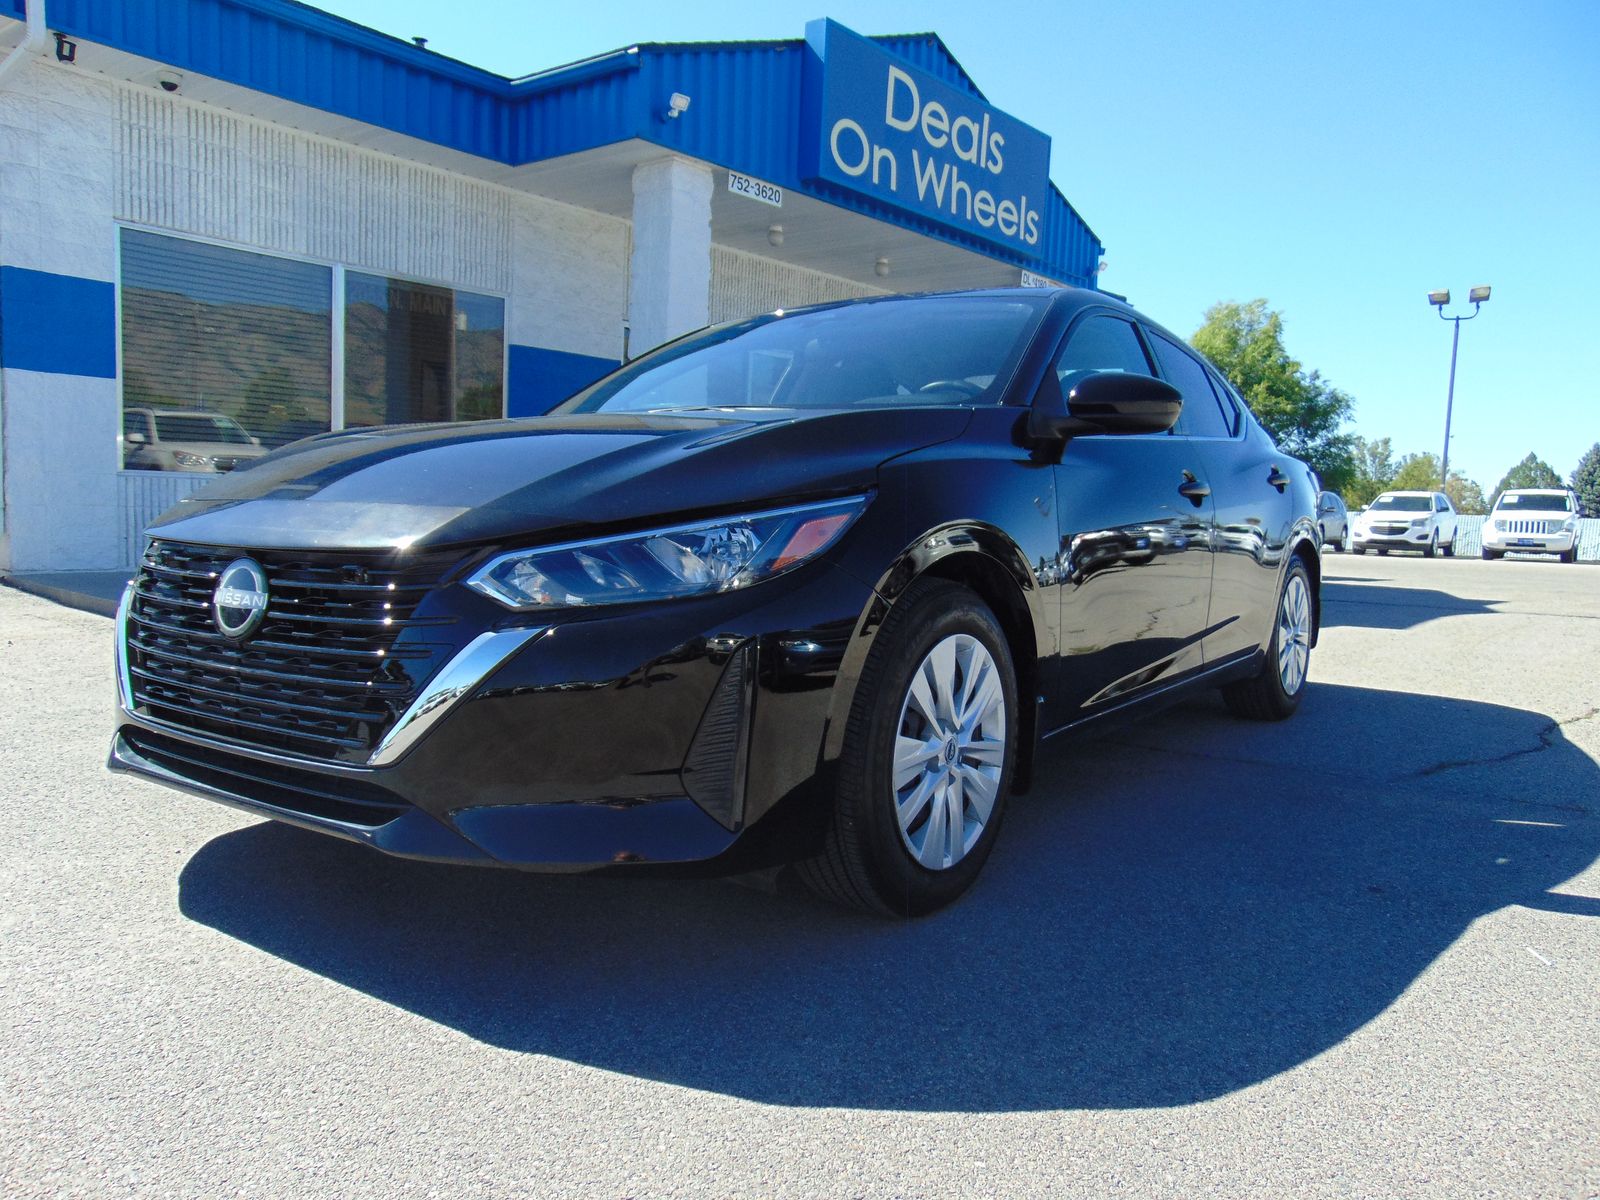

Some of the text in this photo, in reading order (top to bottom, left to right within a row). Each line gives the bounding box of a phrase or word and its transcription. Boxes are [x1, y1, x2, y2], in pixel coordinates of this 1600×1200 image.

[886, 65, 1005, 175] Deals
[730, 174, 781, 203] 752-3620
[830, 118, 1039, 246] On Wheels
[409, 290, 446, 317] MAIN
